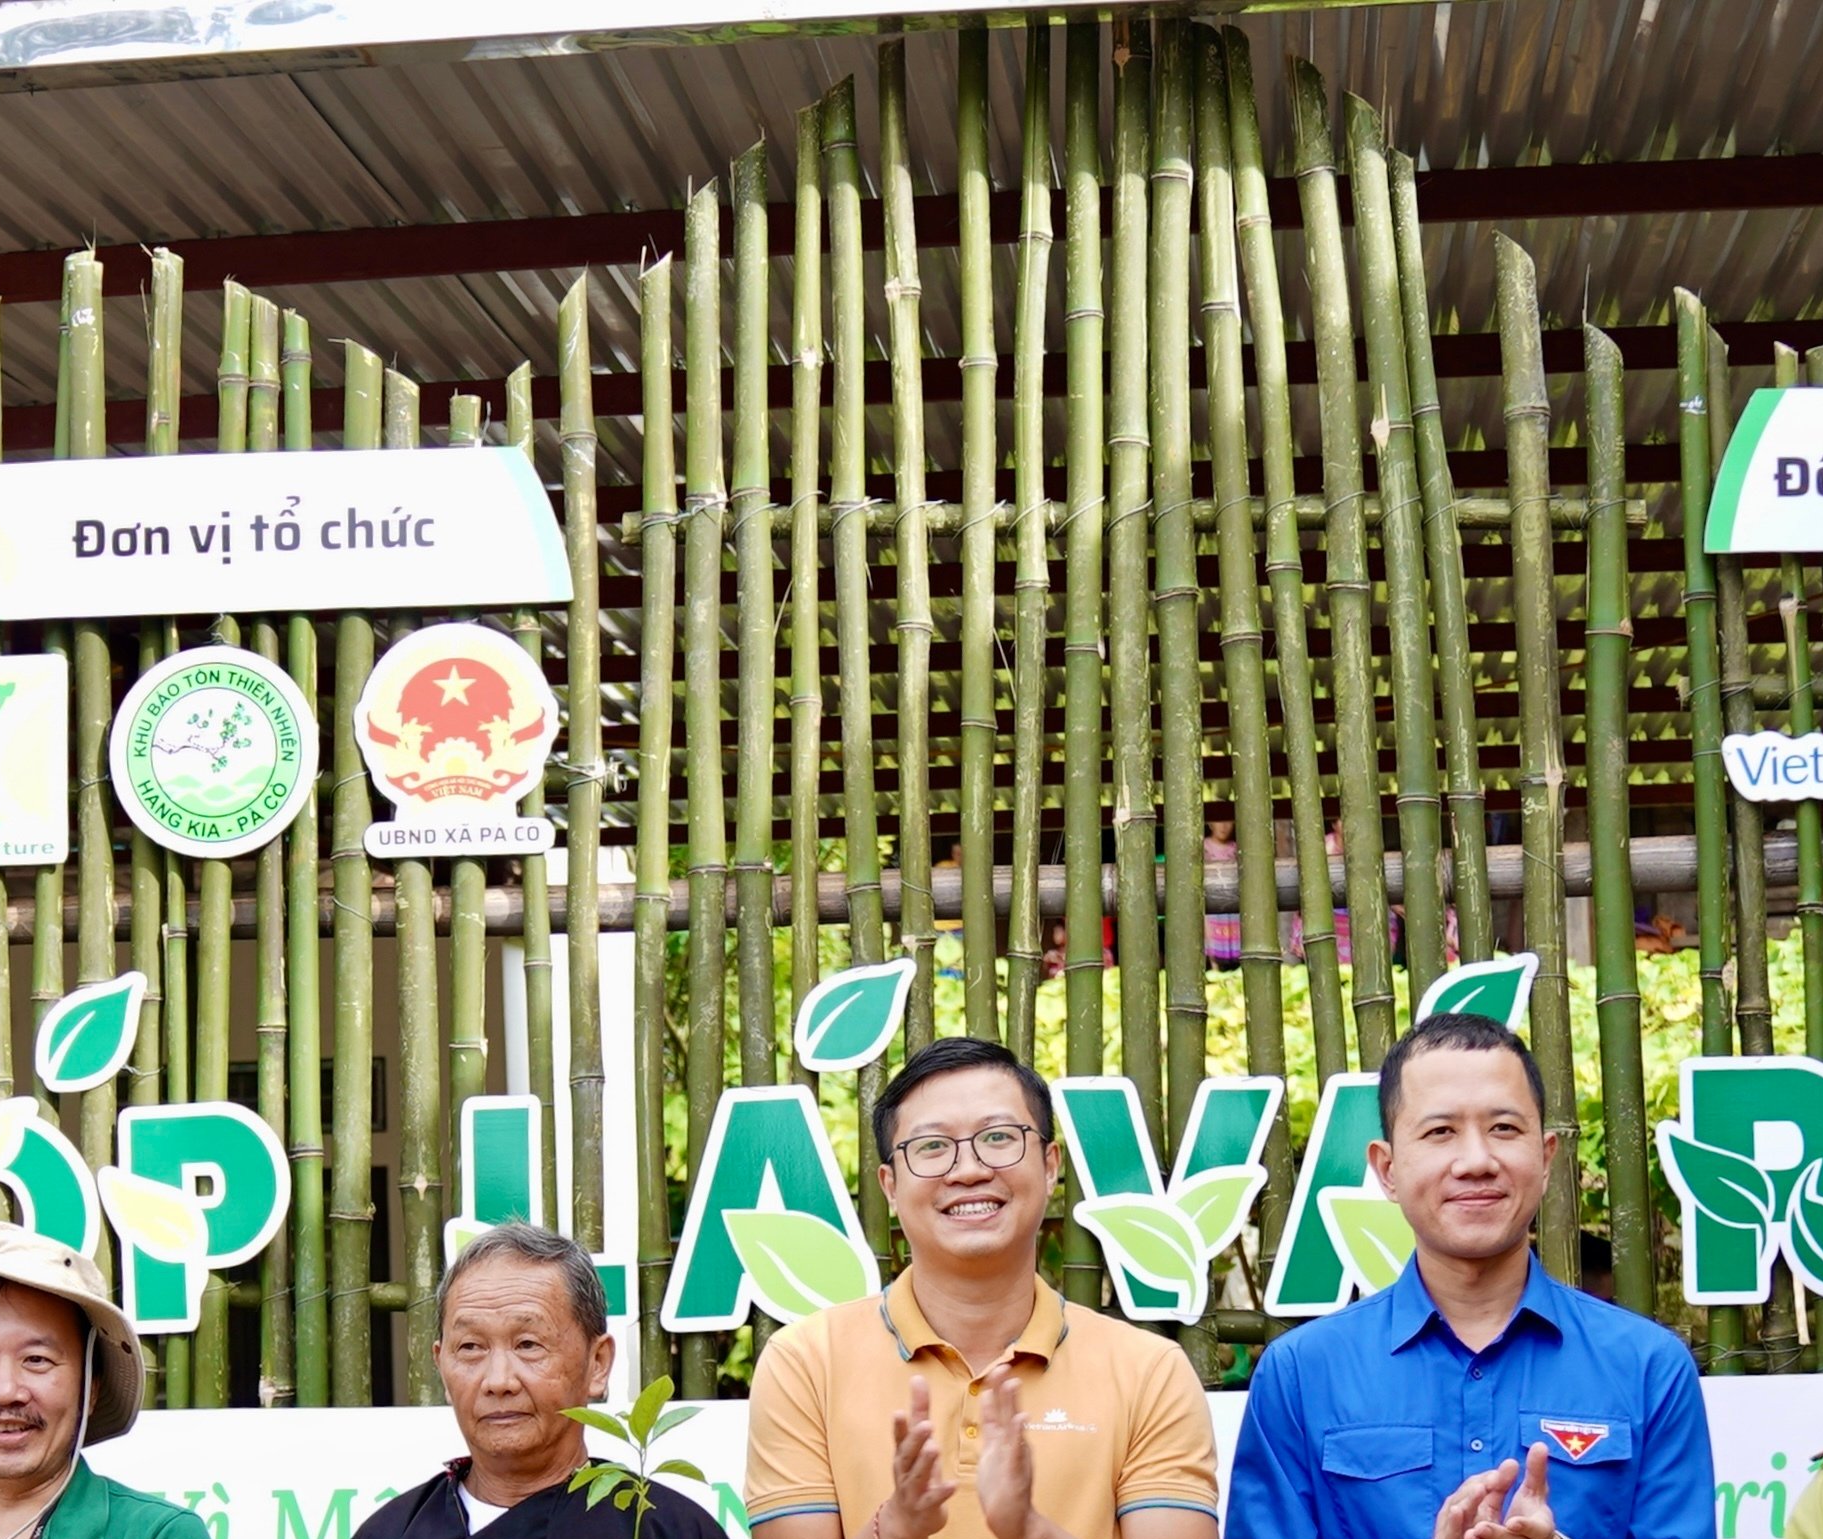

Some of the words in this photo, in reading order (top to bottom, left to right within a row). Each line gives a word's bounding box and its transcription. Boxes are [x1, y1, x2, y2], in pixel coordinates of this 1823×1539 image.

[72, 519, 170, 558] Đơn
[189, 511, 231, 565] vị
[250, 495, 302, 552] tổ
[320, 506, 436, 550] chức
[133, 719, 152, 757] KHU
[271, 706, 297, 762] NHIÊN
[137, 779, 183, 828] HANG
[186, 819, 221, 837] KIA
[379, 830, 436, 845] UBND
[445, 824, 472, 843] XÃ
